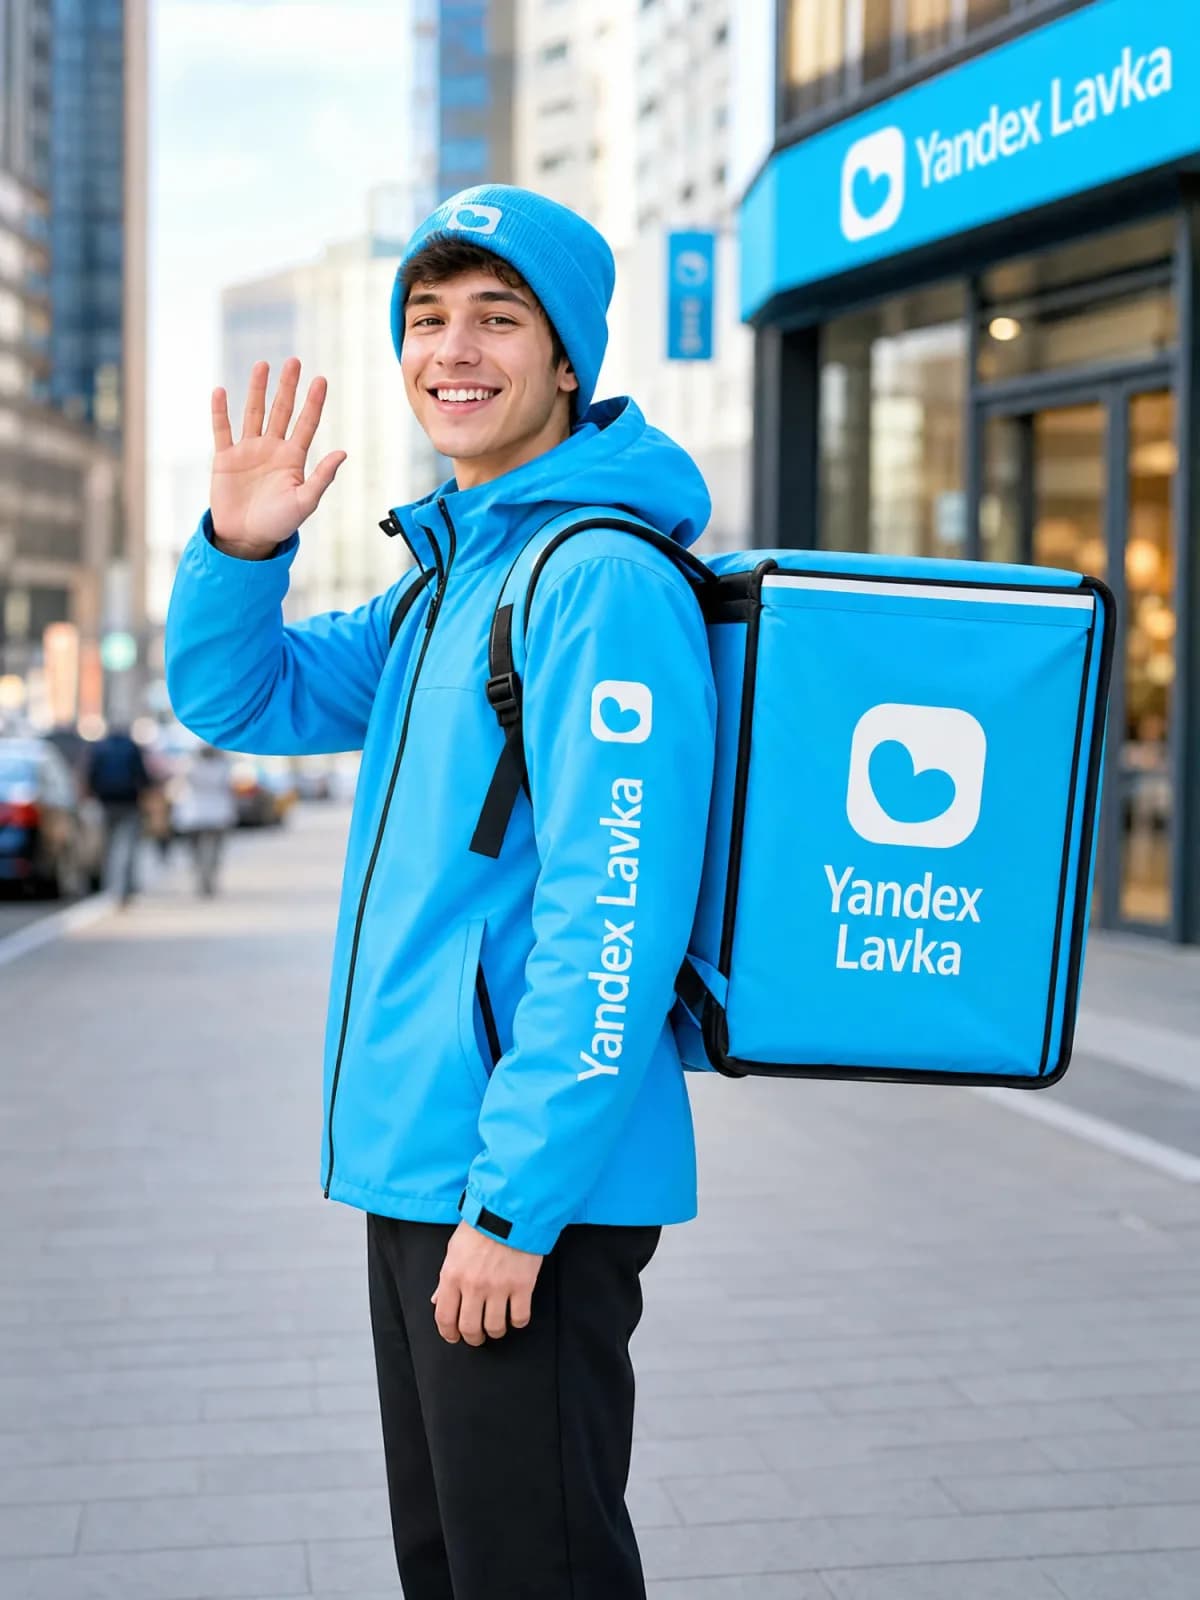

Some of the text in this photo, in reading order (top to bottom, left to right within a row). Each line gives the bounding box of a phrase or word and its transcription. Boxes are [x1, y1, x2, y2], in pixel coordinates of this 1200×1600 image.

[915, 46, 1173, 188] Yandex Lavka
[576, 778, 643, 1081] Yandex Lavka
[824, 864, 983, 923] Yandex
[836, 924, 963, 976] Lavka
